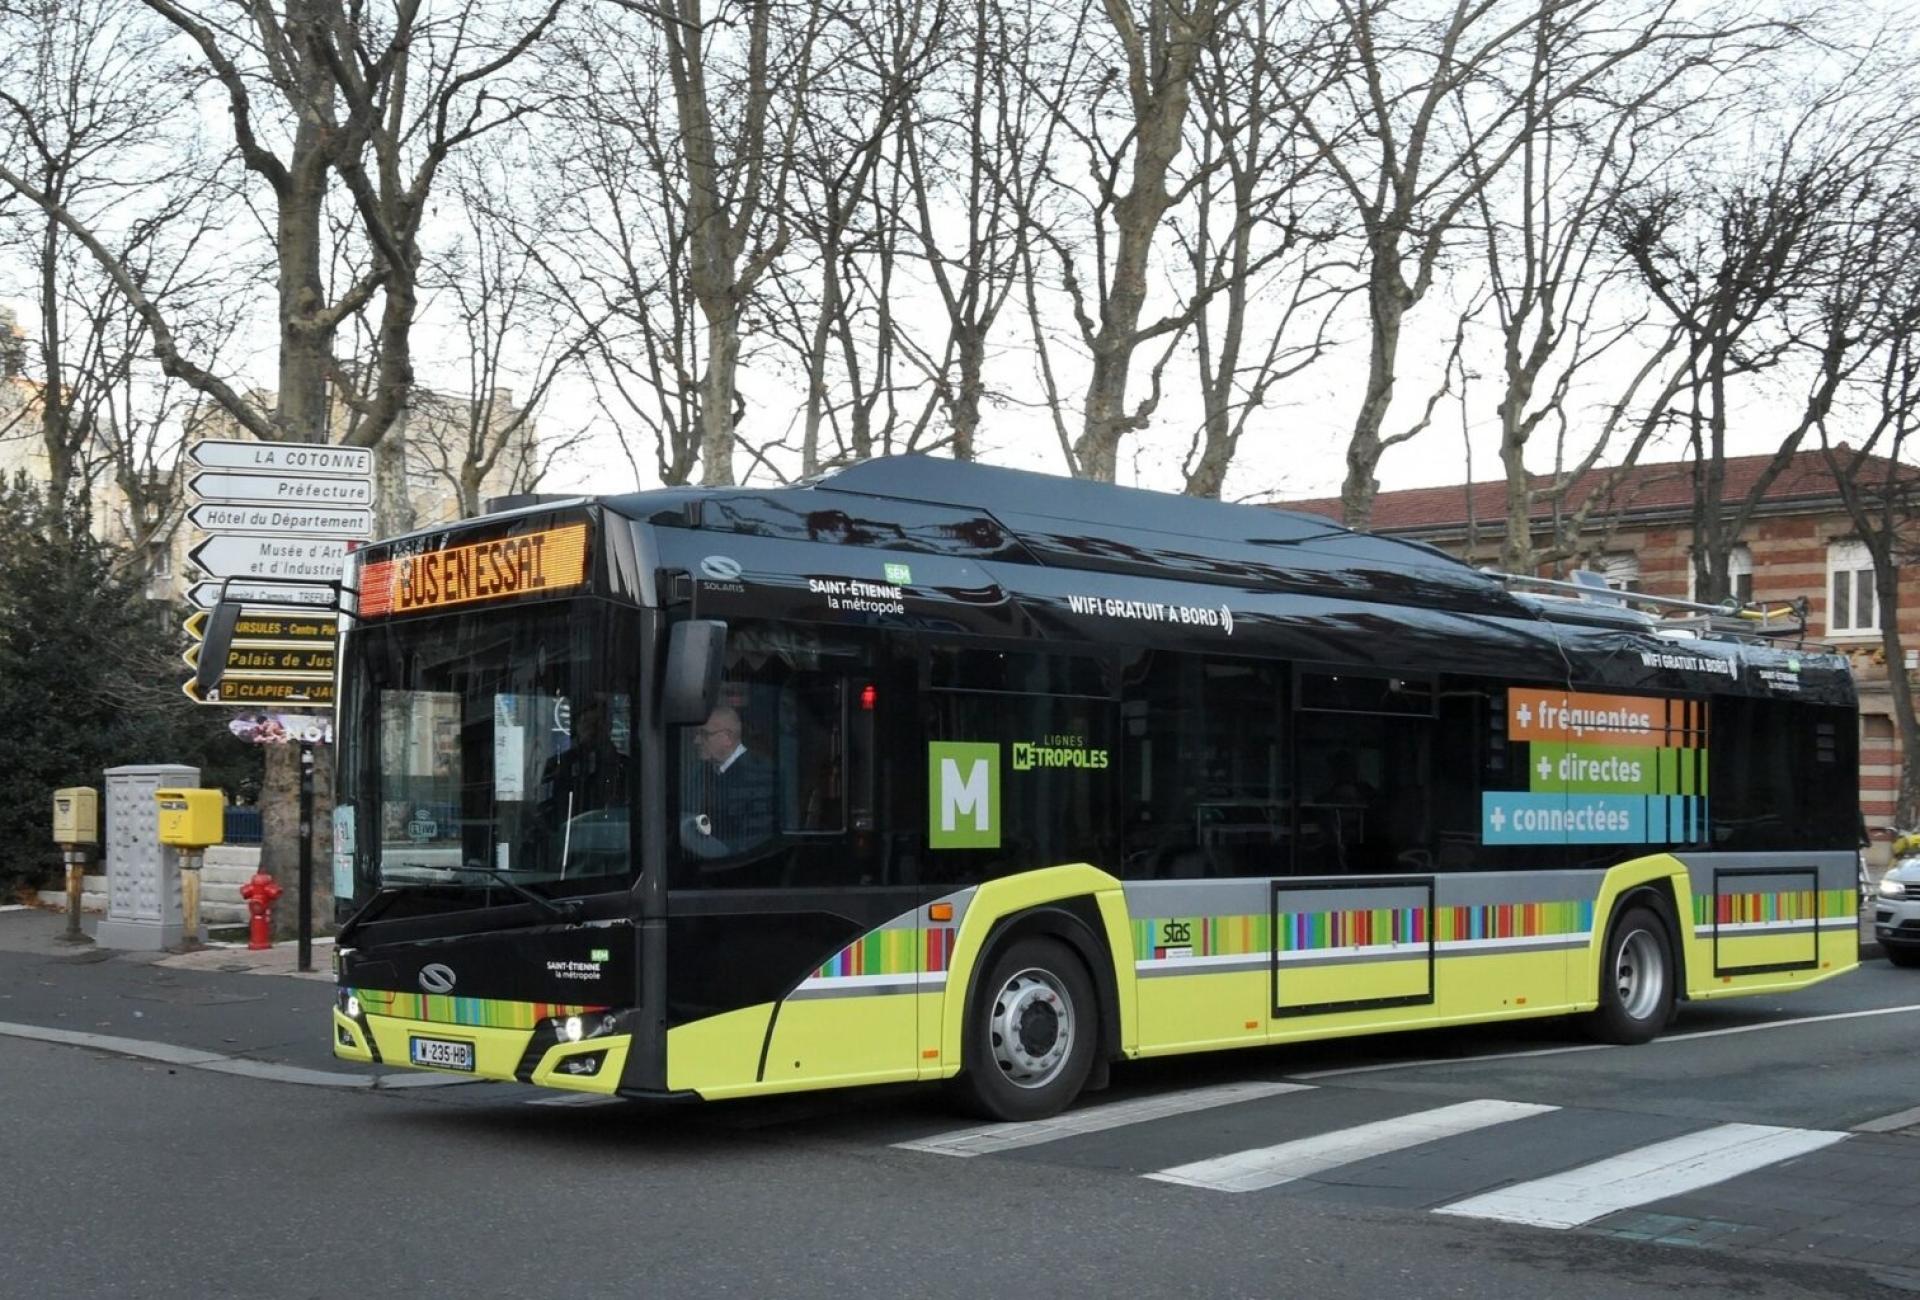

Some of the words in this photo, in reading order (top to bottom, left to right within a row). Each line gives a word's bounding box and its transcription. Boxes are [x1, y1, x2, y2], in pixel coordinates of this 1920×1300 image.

[255, 451, 275, 464] LA
[286, 452, 367, 468] COTONNE
[278, 483, 365, 498] Préfecture
[207, 511, 245, 525] Hôtel
[250, 512, 266, 525] du
[272, 513, 363, 529] Département
[260, 543, 304, 557] Musée
[309, 544, 343, 559] d'Art
[251, 562, 263, 573] et
[271, 562, 343, 575] d'Industrie
[401, 554, 438, 608] BUS
[444, 548, 470, 600] EN
[475, 534, 546, 598] ESSAI
[809, 579, 903, 599] SAINT-ÉTIENNE
[828, 594, 839, 609] la
[842, 597, 904, 616] métropole
[1068, 595, 1103, 616] WIFI
[1105, 599, 1165, 621] GRATUIT
[1169, 605, 1179, 623] A
[1181, 606, 1218, 627] BORD
[235, 622, 281, 634] URSULES
[228, 652, 276, 666] Palais
[281, 653, 300, 666] de
[239, 685, 294, 697] CLAPIER
[1538, 699, 1650, 736] fréquentes
[1044, 735, 1083, 746] LIGNES
[1013, 742, 1108, 769] MÉTROPOLES
[1558, 753, 1642, 782] directes
[941, 758, 989, 831] M
[1513, 801, 1629, 831] connectées
[1163, 918, 1191, 943] stas
[547, 960, 601, 971] SAINT-ÉTIENNE
[555, 970, 562, 978] la
[563, 971, 601, 981] métropole
